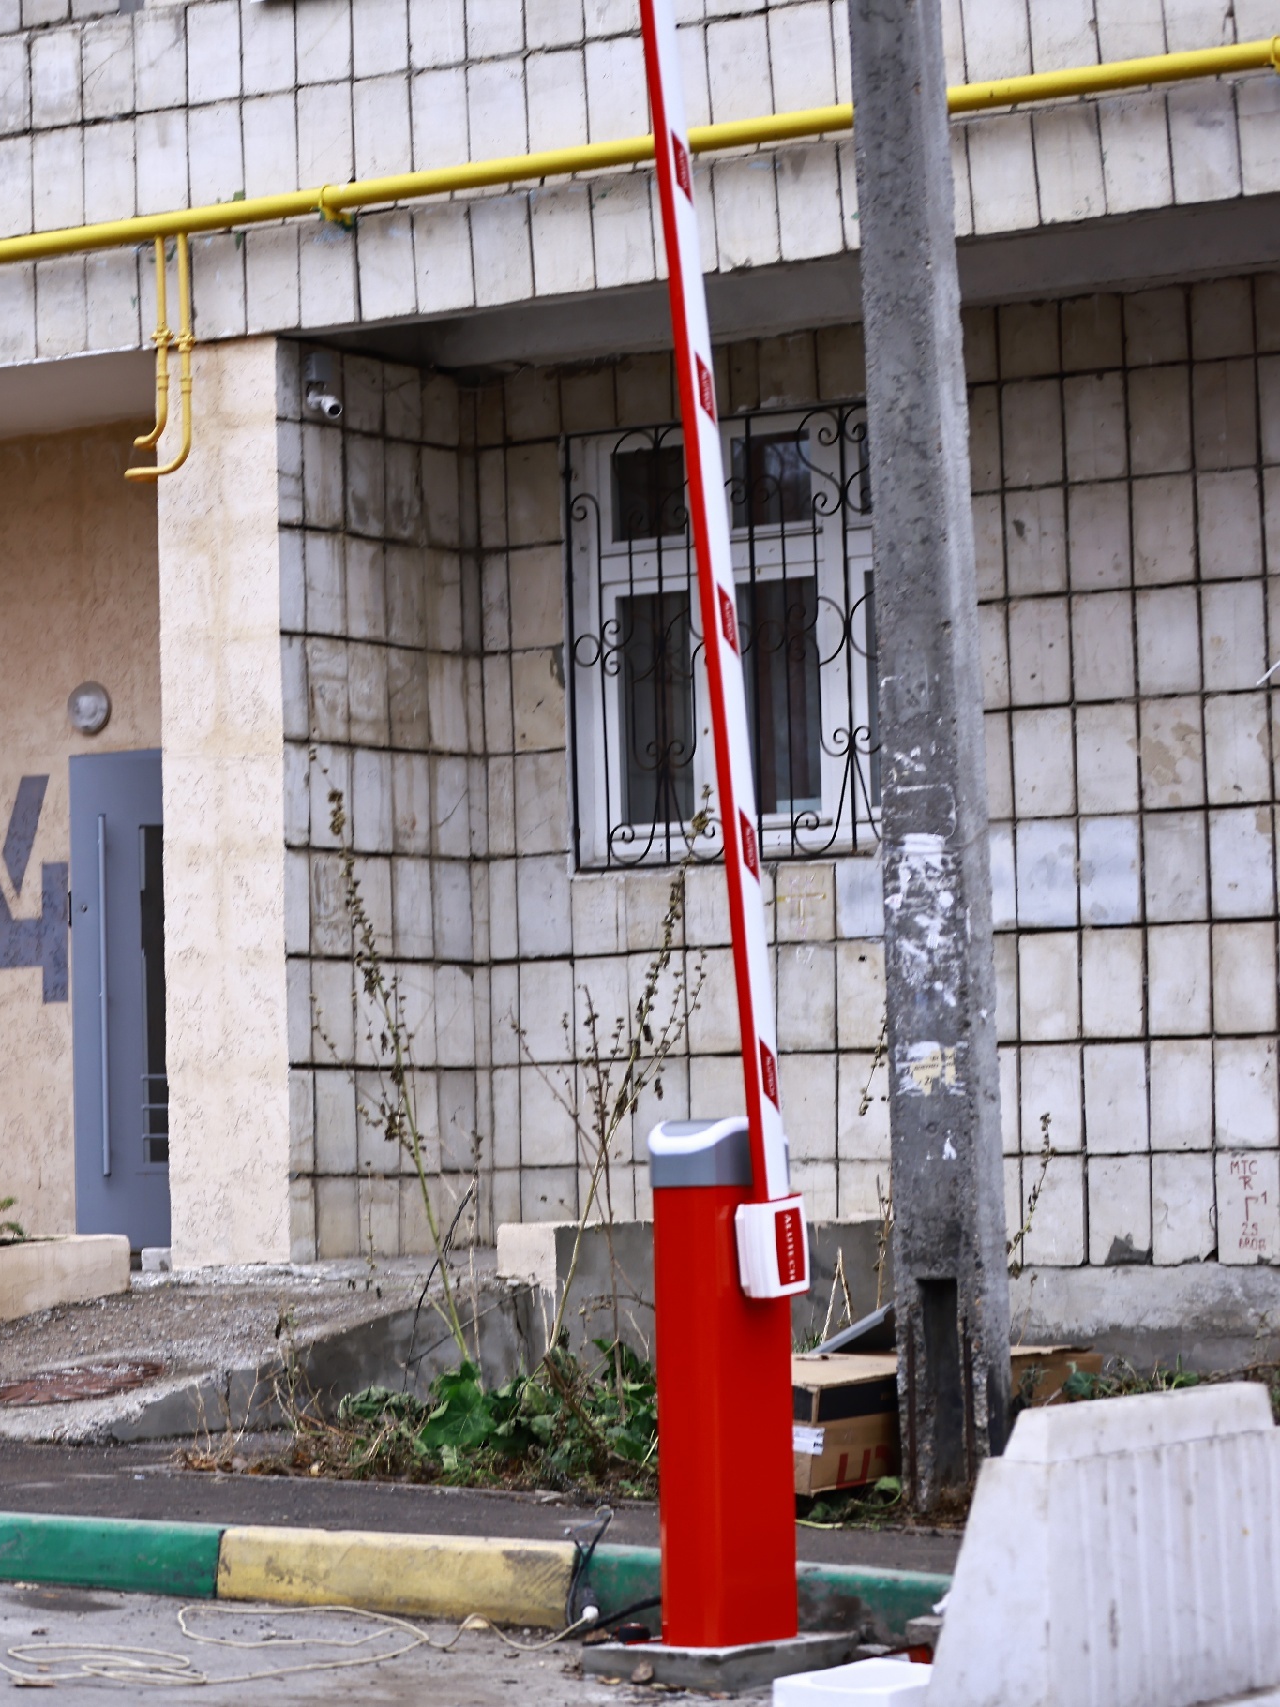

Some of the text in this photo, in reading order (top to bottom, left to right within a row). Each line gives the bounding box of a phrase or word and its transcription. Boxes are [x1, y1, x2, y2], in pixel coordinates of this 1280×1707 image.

[679, 149, 689, 189] ALUTECH
[701, 370, 712, 411] ALUTECH
[725, 601, 736, 641] ALUTECH
[745, 826, 755, 867] ALUTECH
[765, 1055, 775, 1097] ALUTECH
[784, 1213, 796, 1281] ALUTECH
